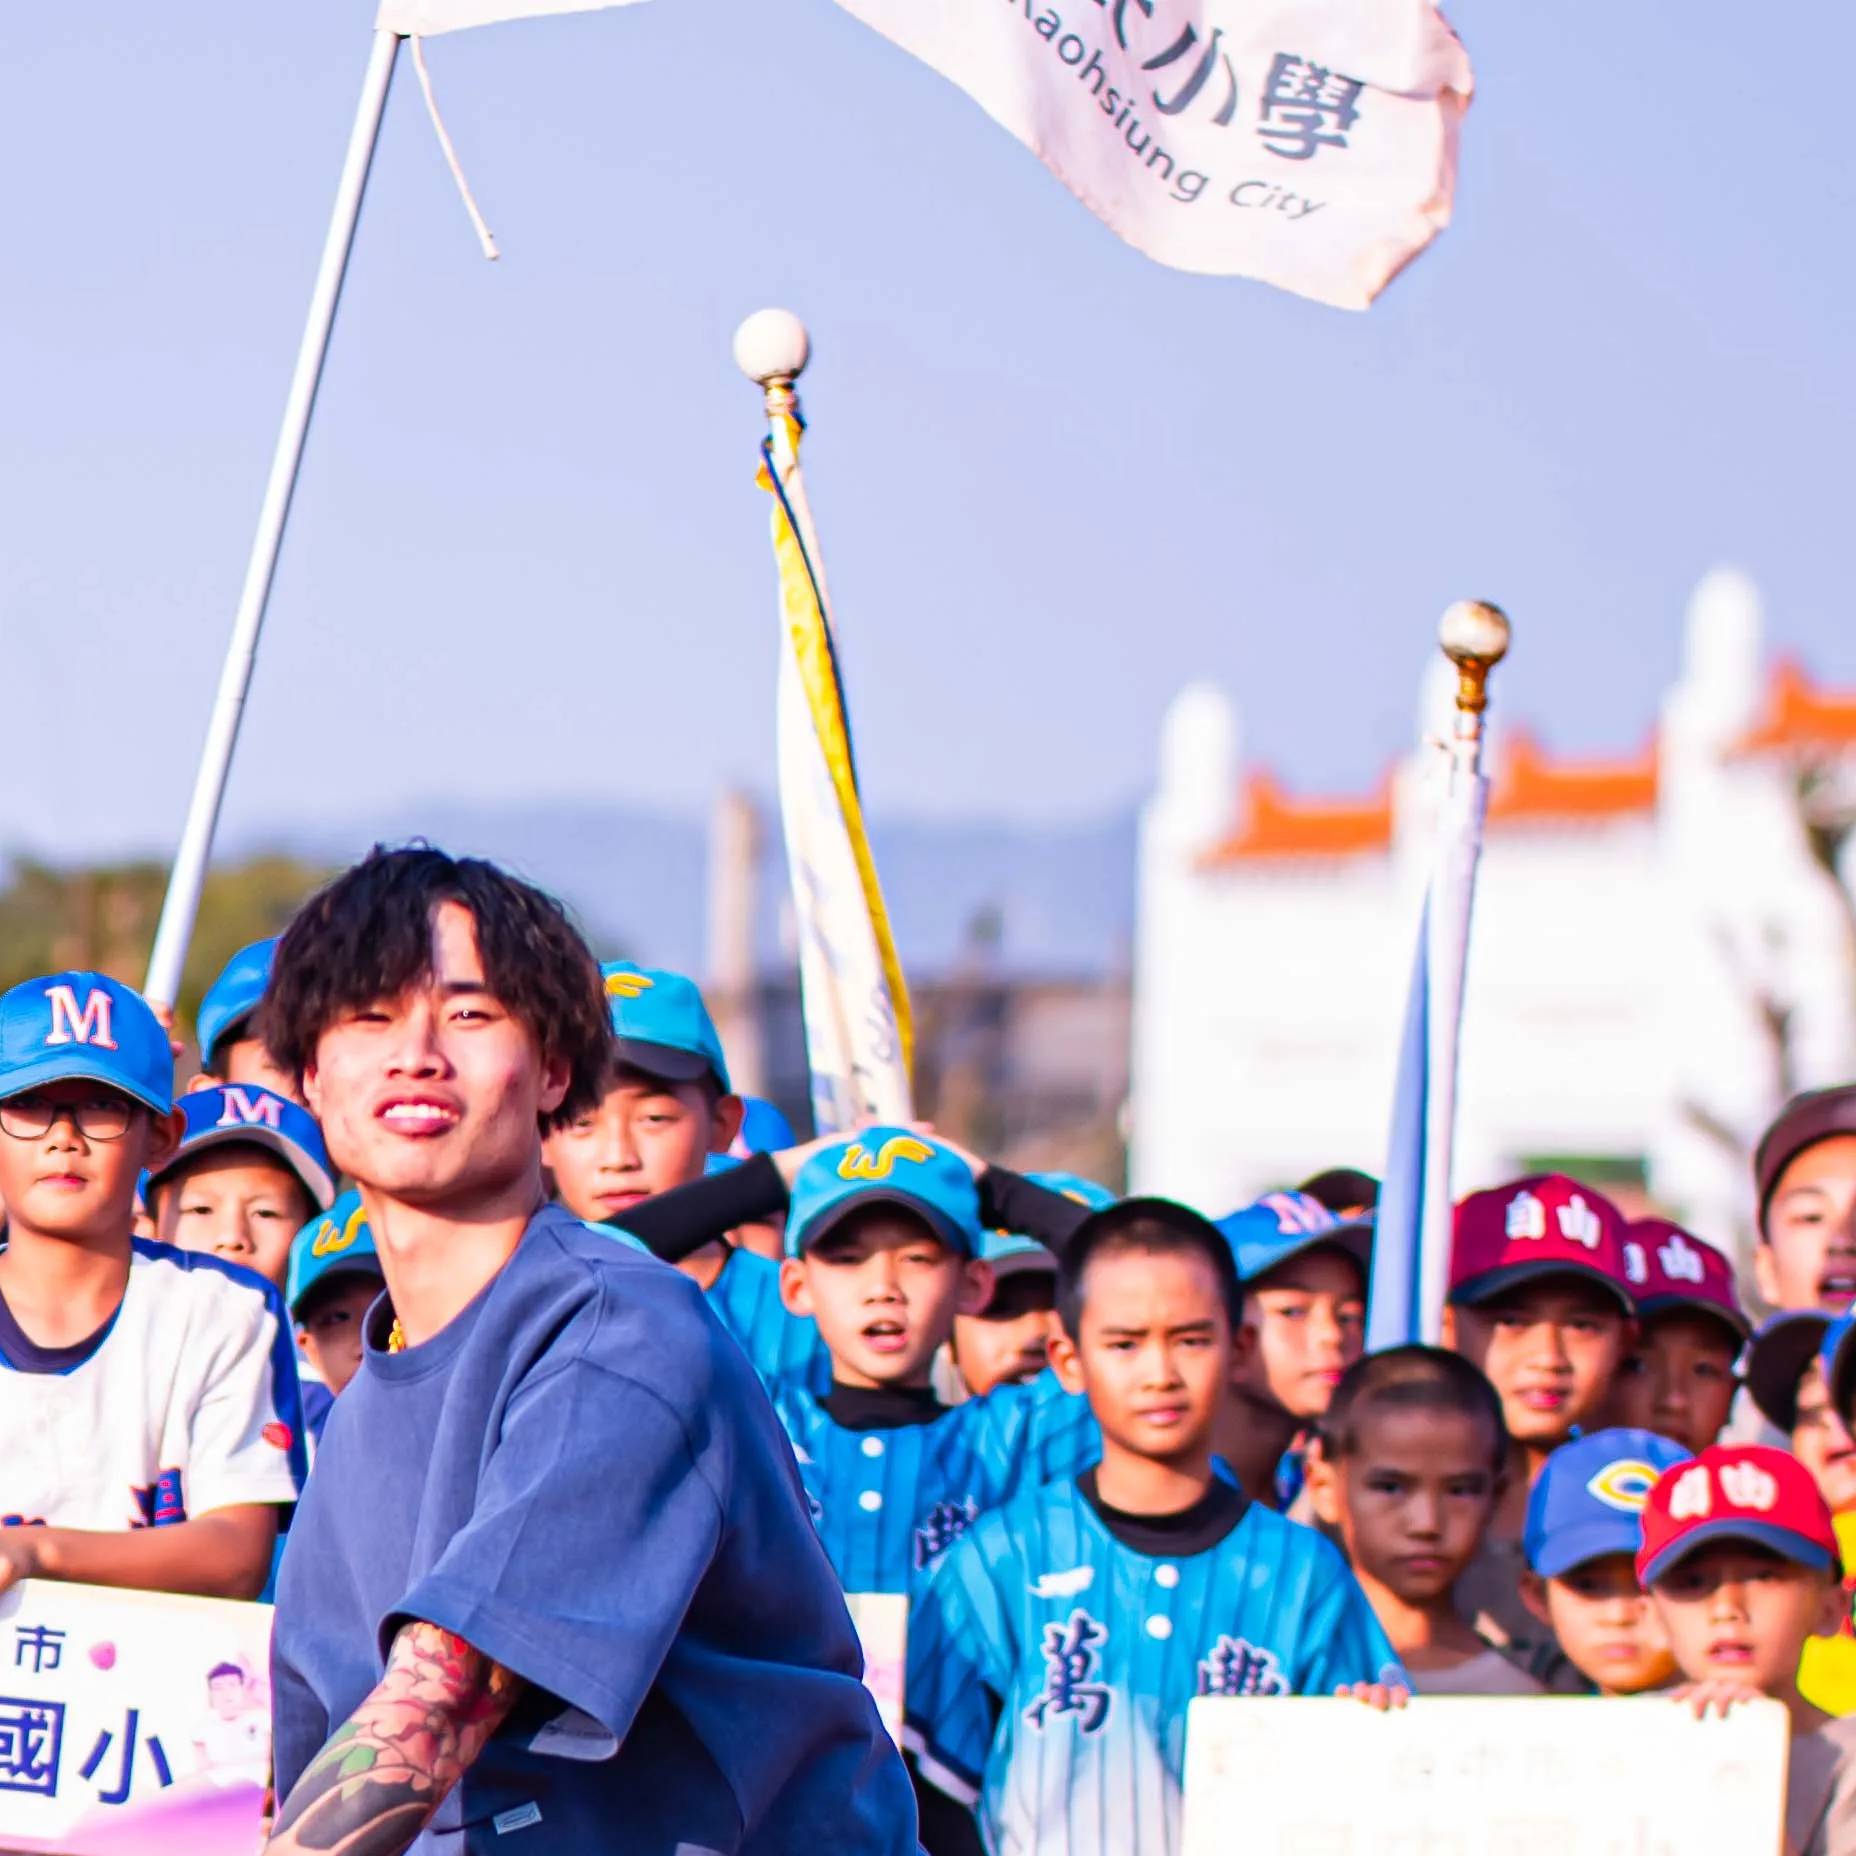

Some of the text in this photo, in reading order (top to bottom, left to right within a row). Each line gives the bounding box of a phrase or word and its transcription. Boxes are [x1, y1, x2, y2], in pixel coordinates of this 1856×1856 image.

[1229, 178, 1328, 220] City
[43, 985, 119, 1051] M
[216, 1085, 286, 1129] M
[1025, 1607, 1112, 1738] 萬
